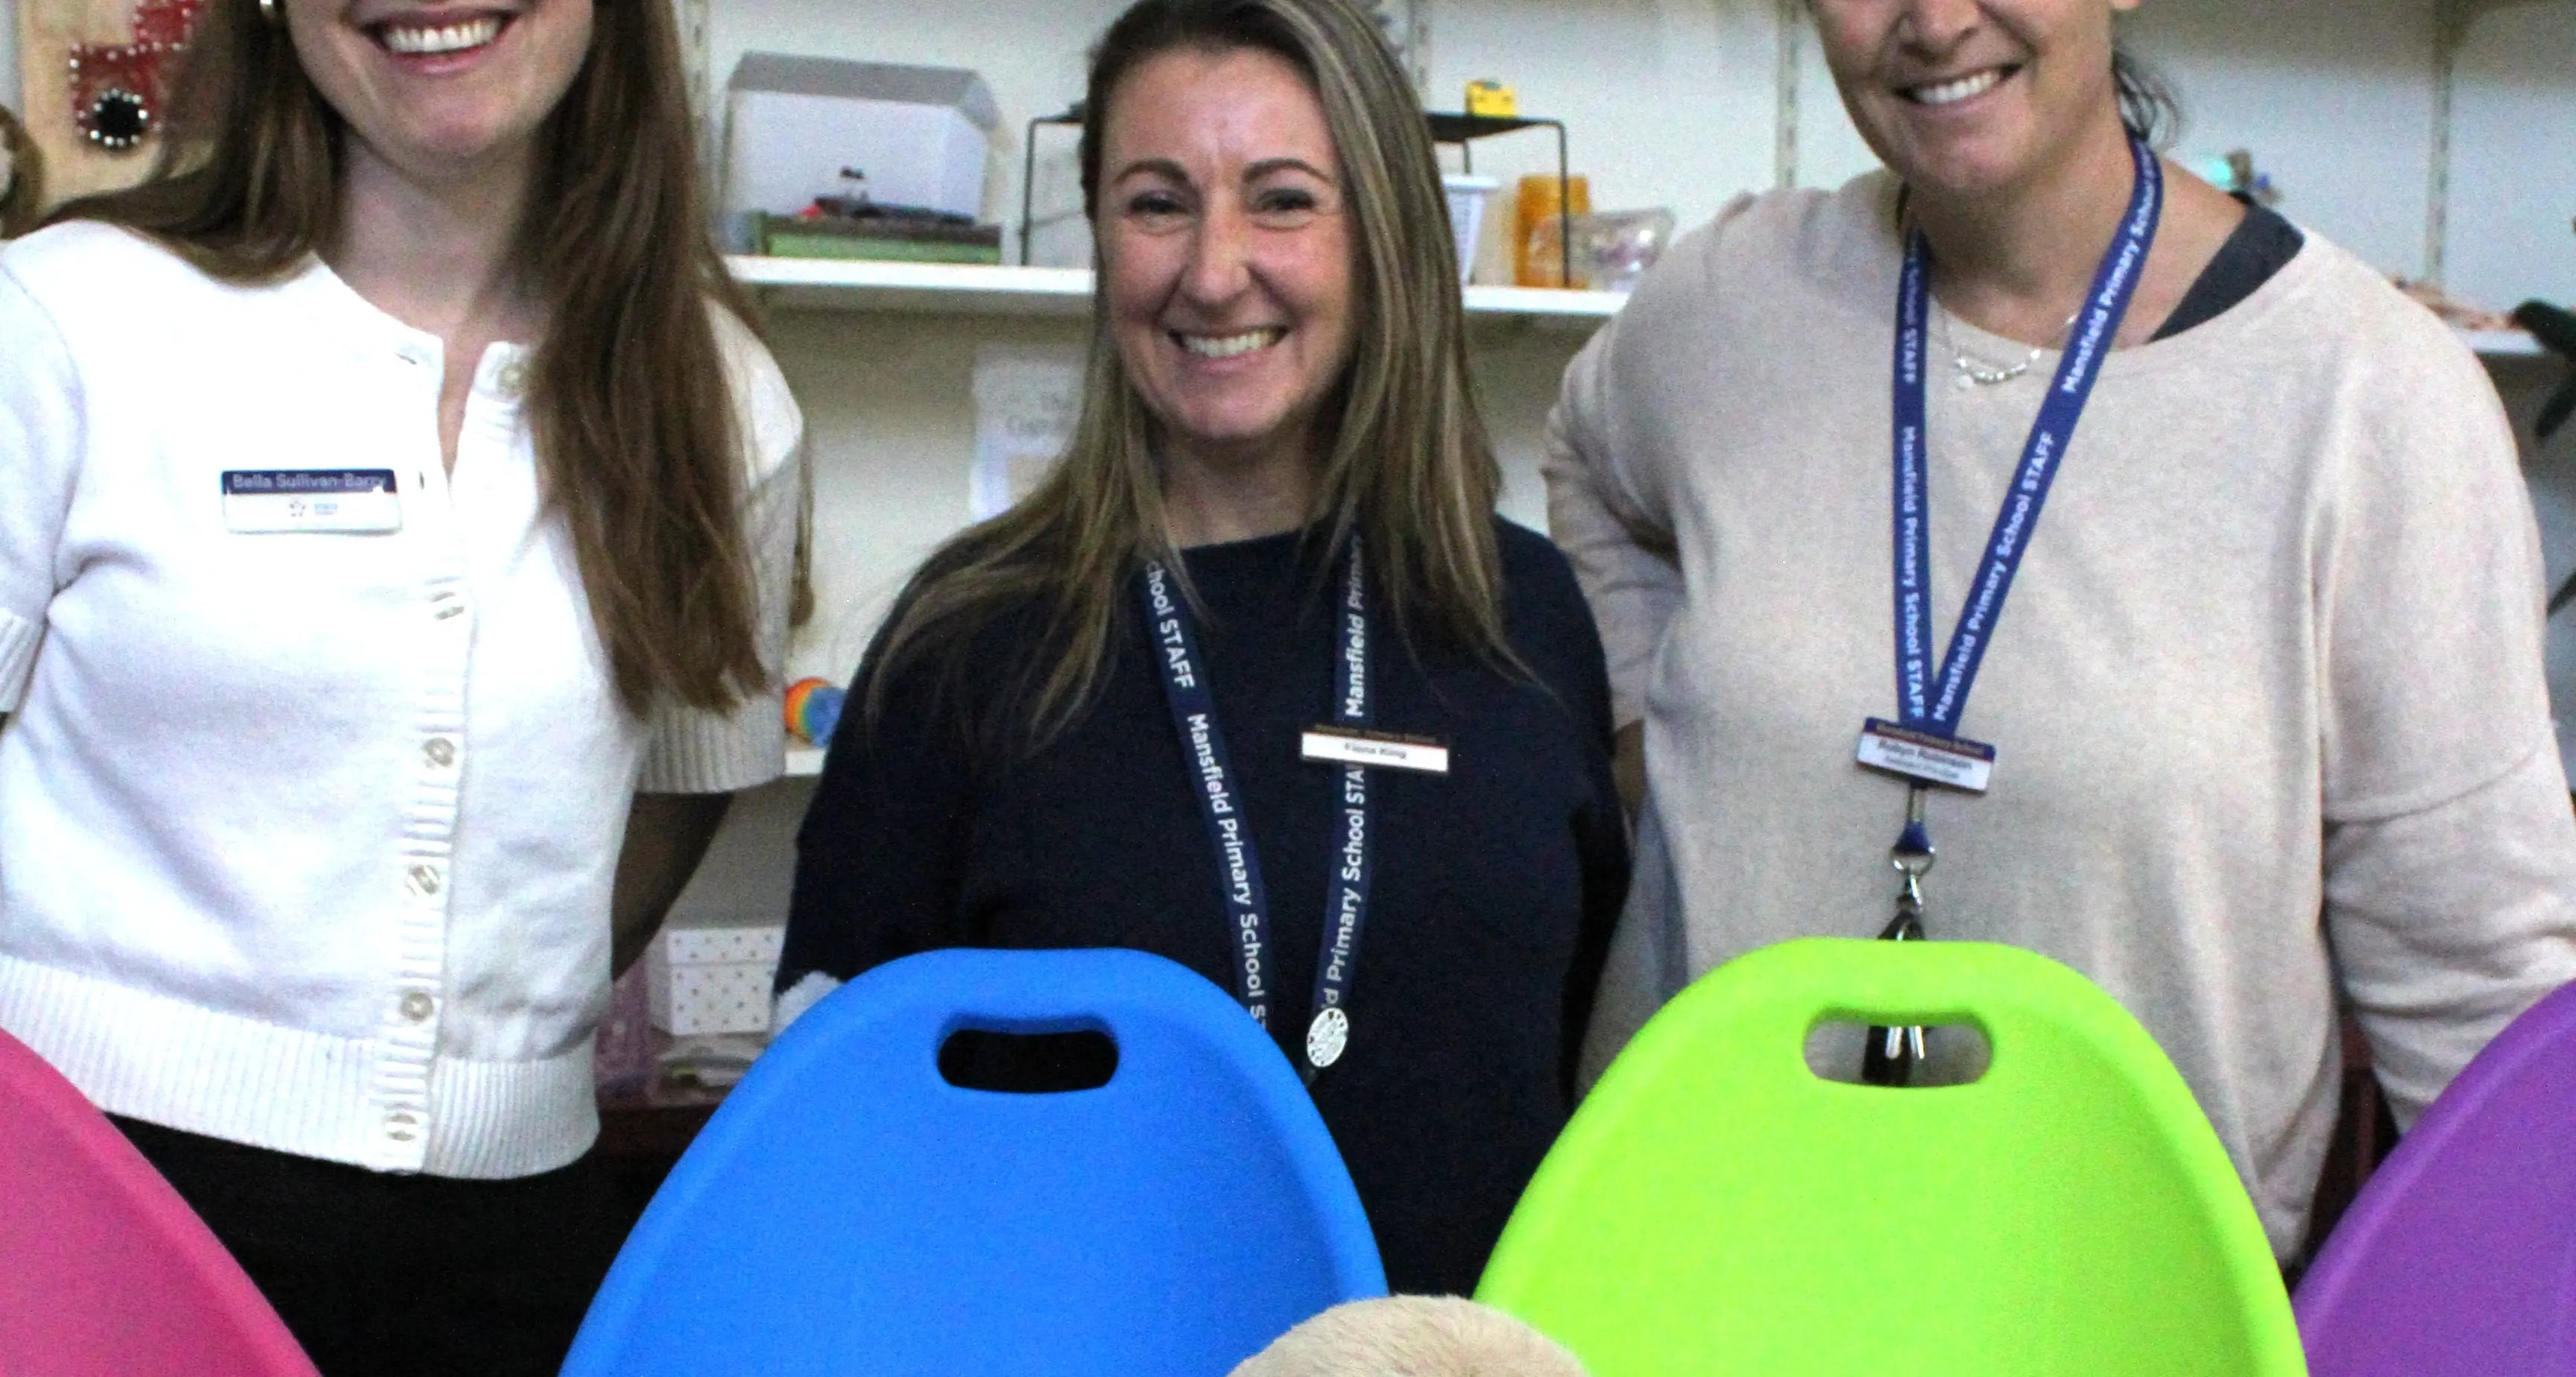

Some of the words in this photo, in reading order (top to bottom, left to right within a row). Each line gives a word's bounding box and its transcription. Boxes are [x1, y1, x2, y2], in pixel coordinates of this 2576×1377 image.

[2062, 308, 2109, 393] Mansfield
[2098, 239, 2141, 307] Primary
[232, 473, 272, 489] Bella
[1902, 425, 1918, 513] Mansfield
[1146, 560, 1175, 617] chool
[1901, 516, 1919, 587] Primary
[1933, 634, 1977, 721] Mansfield
[1967, 560, 2008, 631] Primary
[1996, 493, 2032, 558] School
[2021, 431, 2055, 492] STAFF
[1160, 618, 1196, 688] STAFF
[1904, 592, 1921, 654] School
[1344, 613, 1366, 718] Mansfield
[1906, 659, 1925, 718] STAFF
[1187, 713, 1234, 814] Mansfield
[1218, 817, 1252, 906] Primary
[1342, 808, 1365, 881] School
[1239, 913, 1265, 997] School
[1326, 887, 1362, 981] Primary
